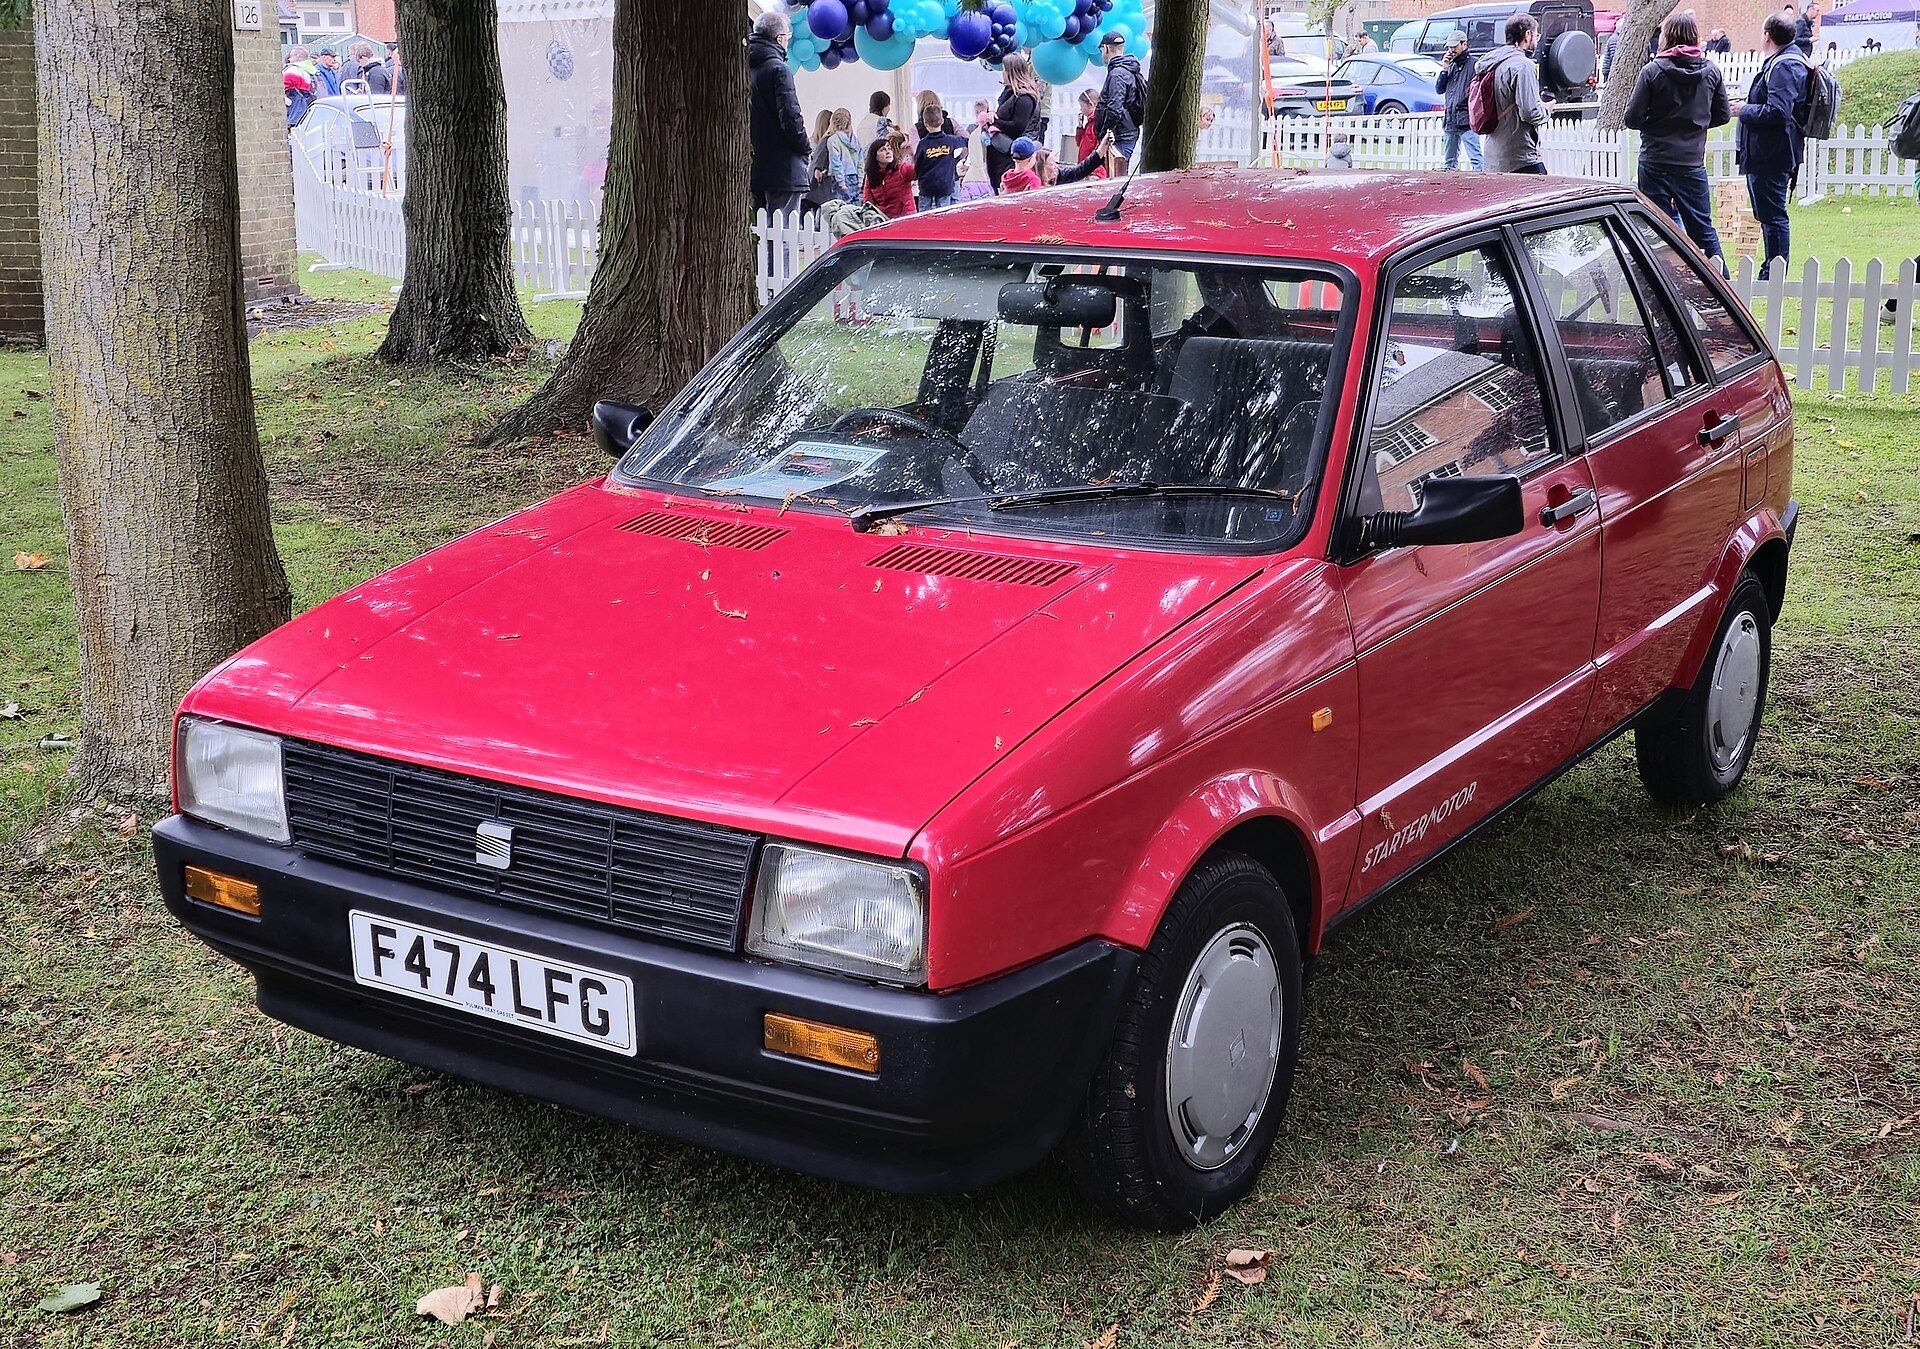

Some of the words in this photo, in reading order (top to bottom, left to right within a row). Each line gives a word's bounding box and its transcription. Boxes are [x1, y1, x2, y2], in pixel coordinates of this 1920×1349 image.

[240, 5, 259, 24] 126
[1361, 781, 1477, 873] STARTERMOTOR
[370, 923, 496, 1007] F474
[509, 958, 611, 1037] LFG
